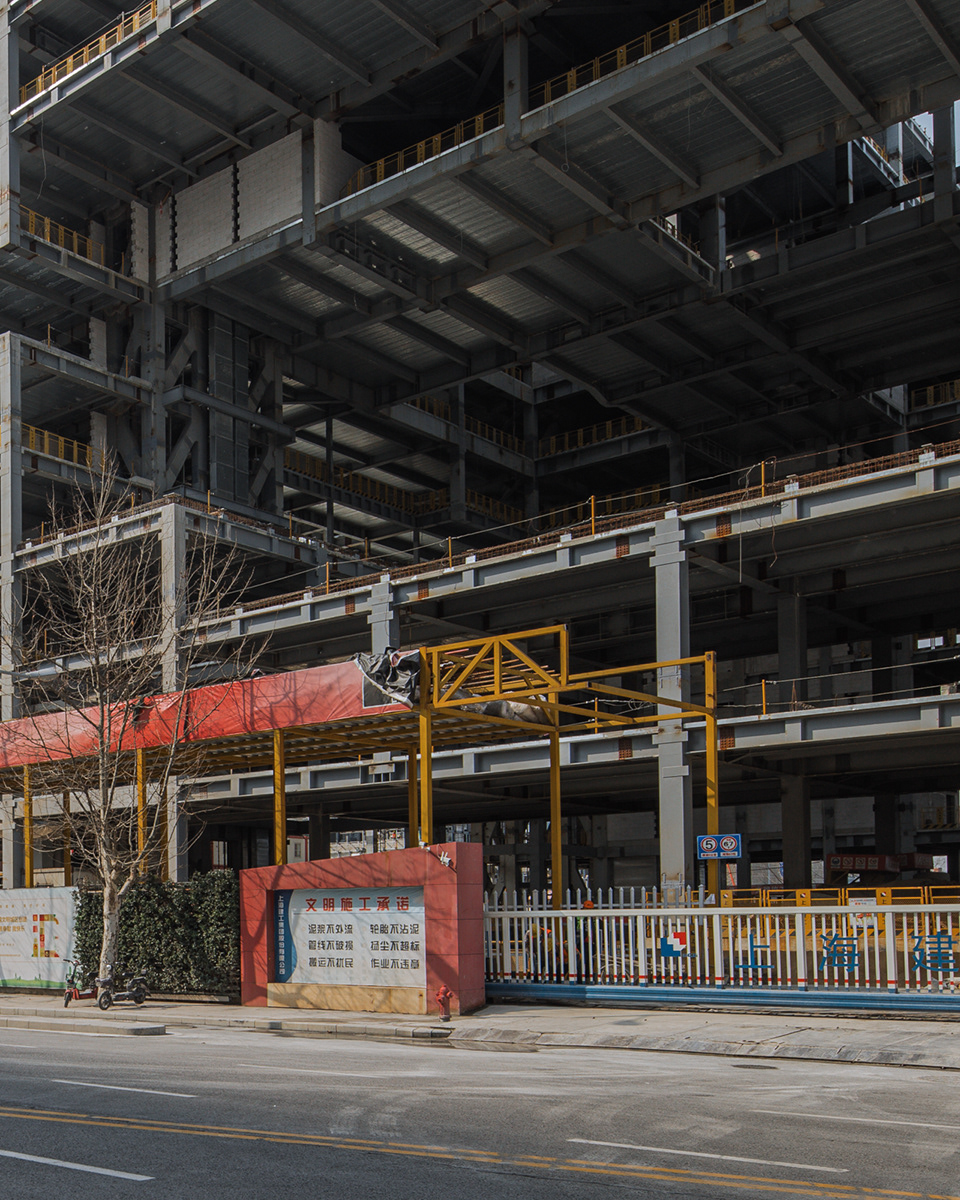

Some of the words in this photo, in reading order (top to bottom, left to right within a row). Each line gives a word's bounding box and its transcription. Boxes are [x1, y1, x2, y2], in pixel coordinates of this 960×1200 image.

[705, 840, 713, 850] 5
[305, 896, 409, 912] 文明施工承诺
[308, 924, 353, 935] 泥浆不外流
[370, 924, 419, 935] 轮胎不沾泥
[308, 940, 354, 951] 管线不破损
[370, 941, 420, 951] 扬尘不超标
[308, 957, 354, 968] 搬运不扰民
[370, 958, 420, 969] 作业不违章
